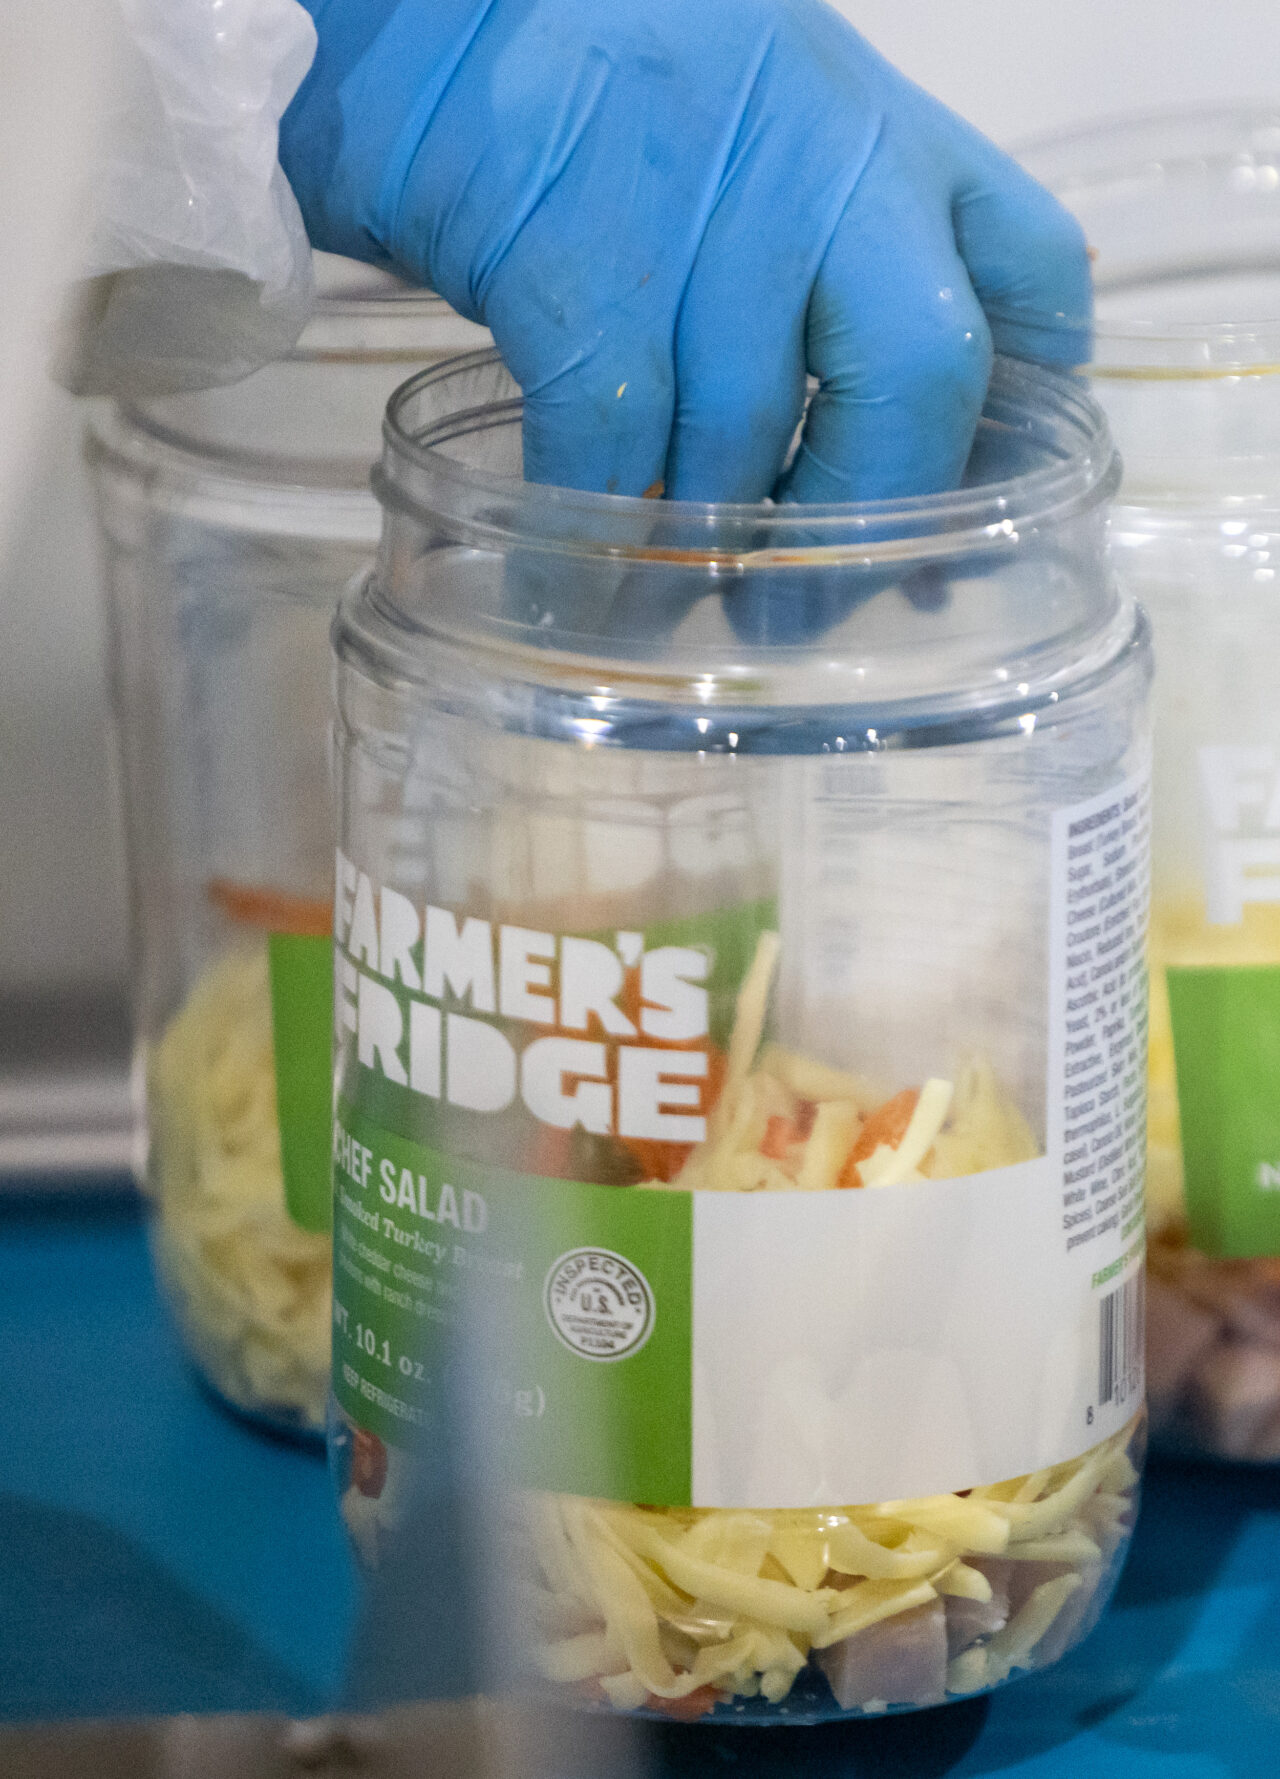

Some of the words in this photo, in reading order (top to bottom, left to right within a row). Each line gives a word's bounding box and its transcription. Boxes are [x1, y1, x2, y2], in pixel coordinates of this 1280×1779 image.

[335, 846, 709, 1041] FARMER'S
[333, 948, 709, 1143] FRIDGE
[380, 1158, 489, 1234] SALAD
[382, 1216, 447, 1265] Turkey
[555, 1256, 642, 1306] INSPECTED
[581, 1292, 613, 1315] U.S.
[356, 1321, 392, 1367] 10.1
[399, 1355, 432, 1386] oz.
